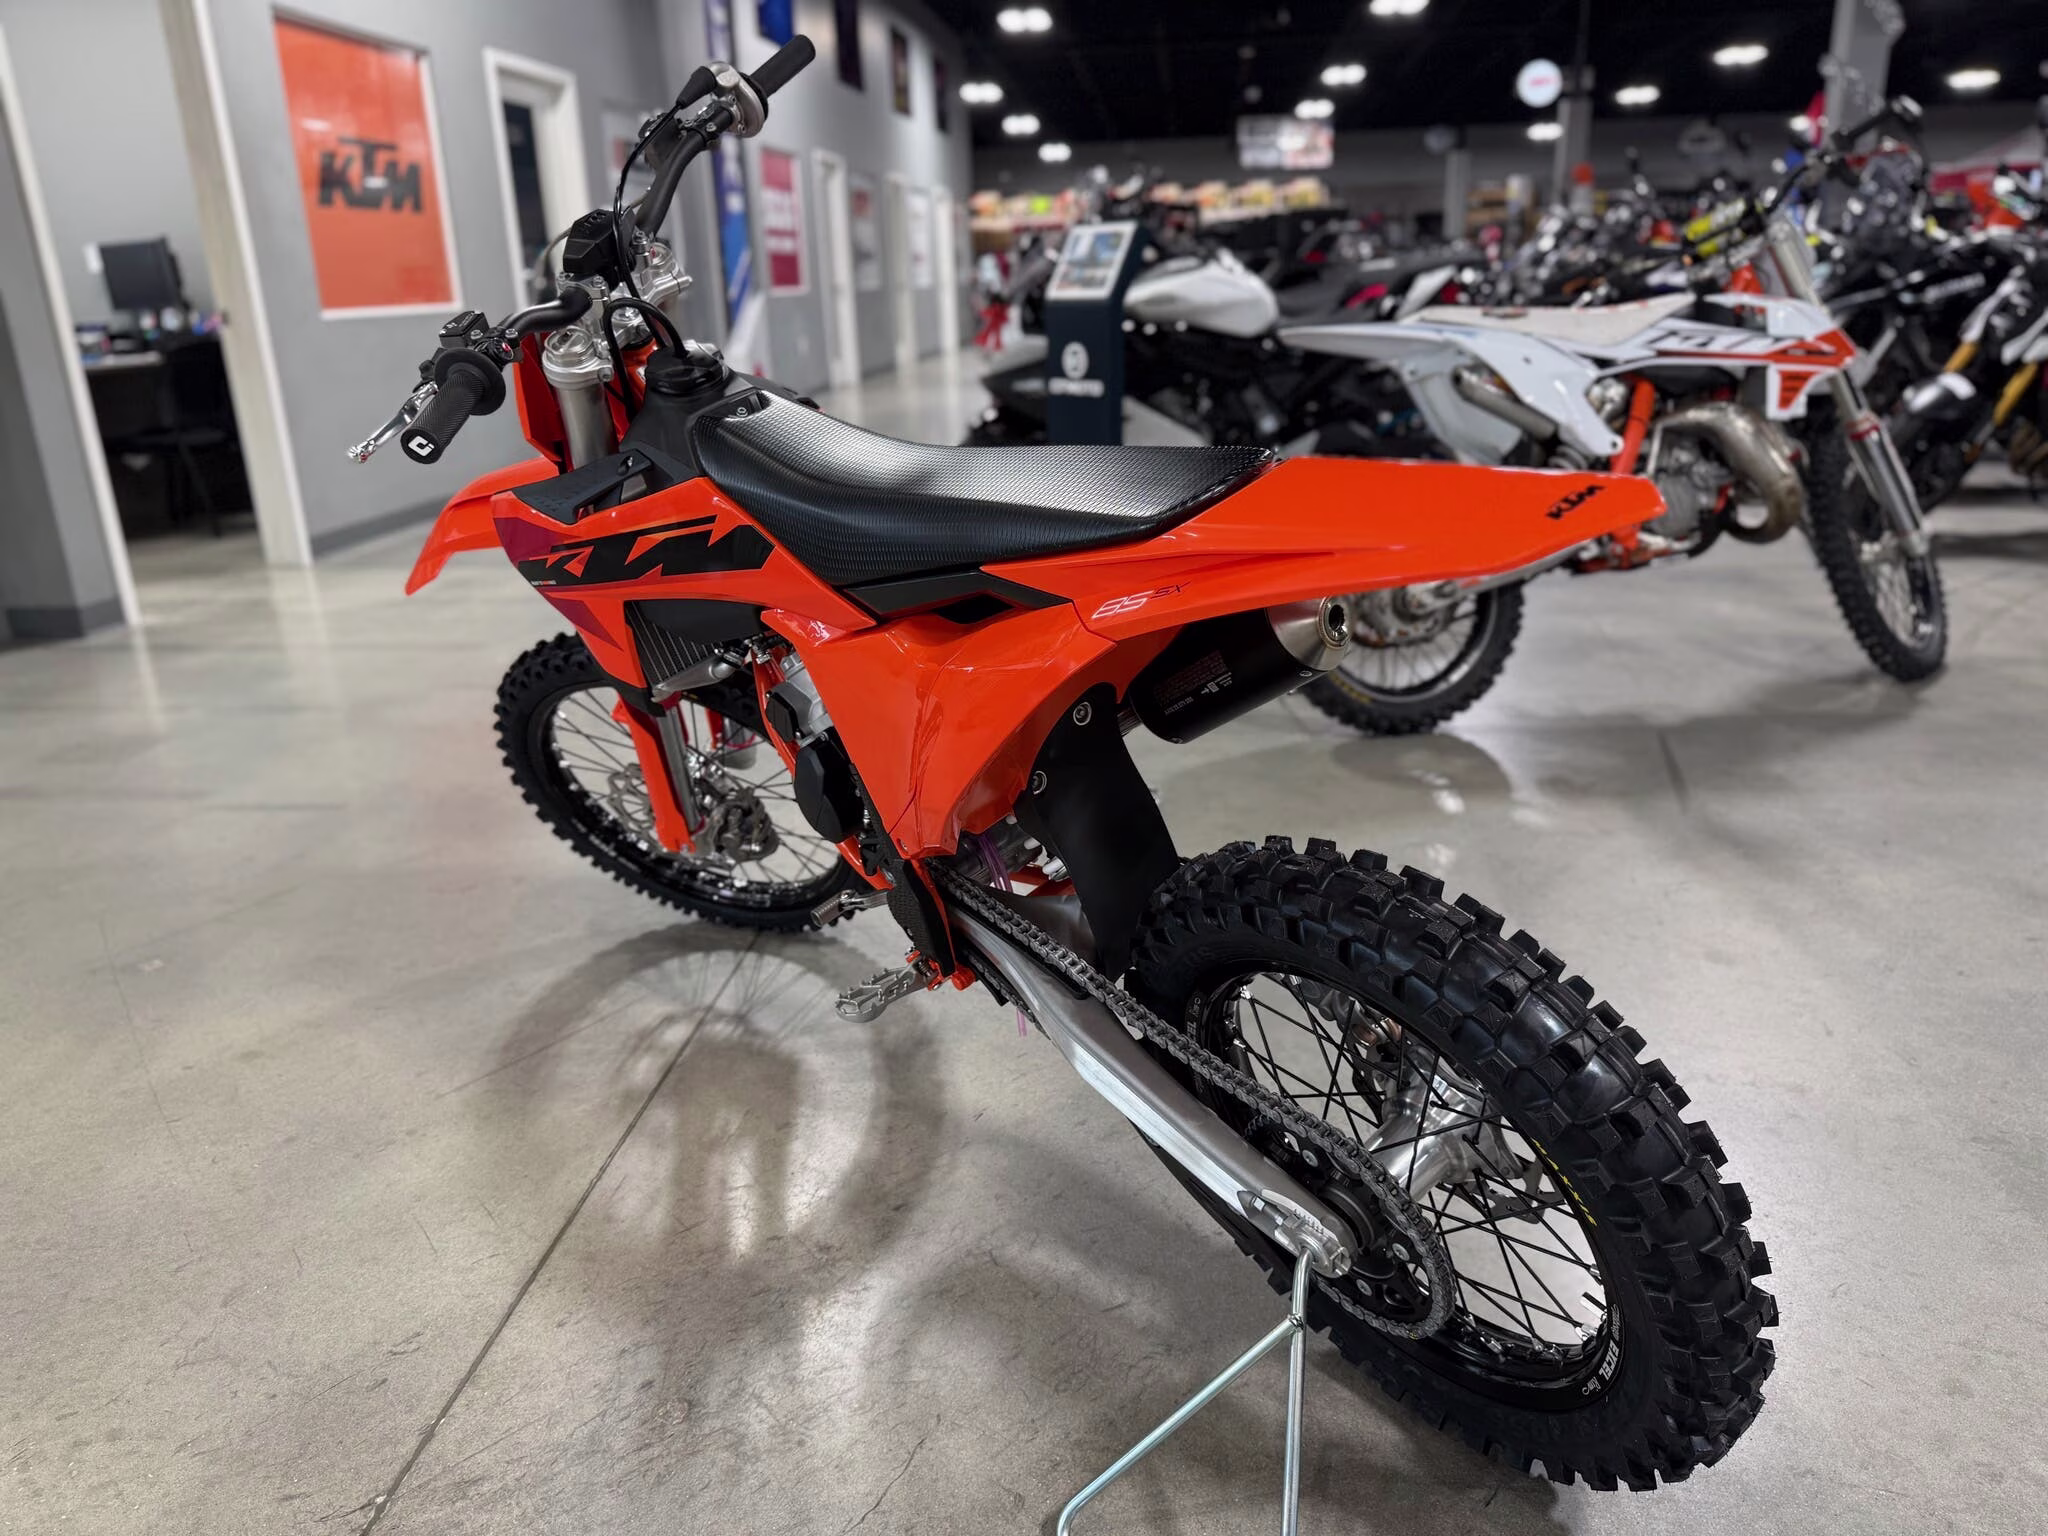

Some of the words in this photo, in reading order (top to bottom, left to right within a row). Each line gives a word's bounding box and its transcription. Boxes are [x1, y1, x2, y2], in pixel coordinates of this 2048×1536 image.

[318, 136, 424, 214] KTM
[1545, 485, 1607, 521] KTM
[518, 513, 777, 587] KTM
[1091, 589, 1155, 619] 85
[1150, 580, 1192, 599] SX
[1598, 1339, 1620, 1381] EXCEL
